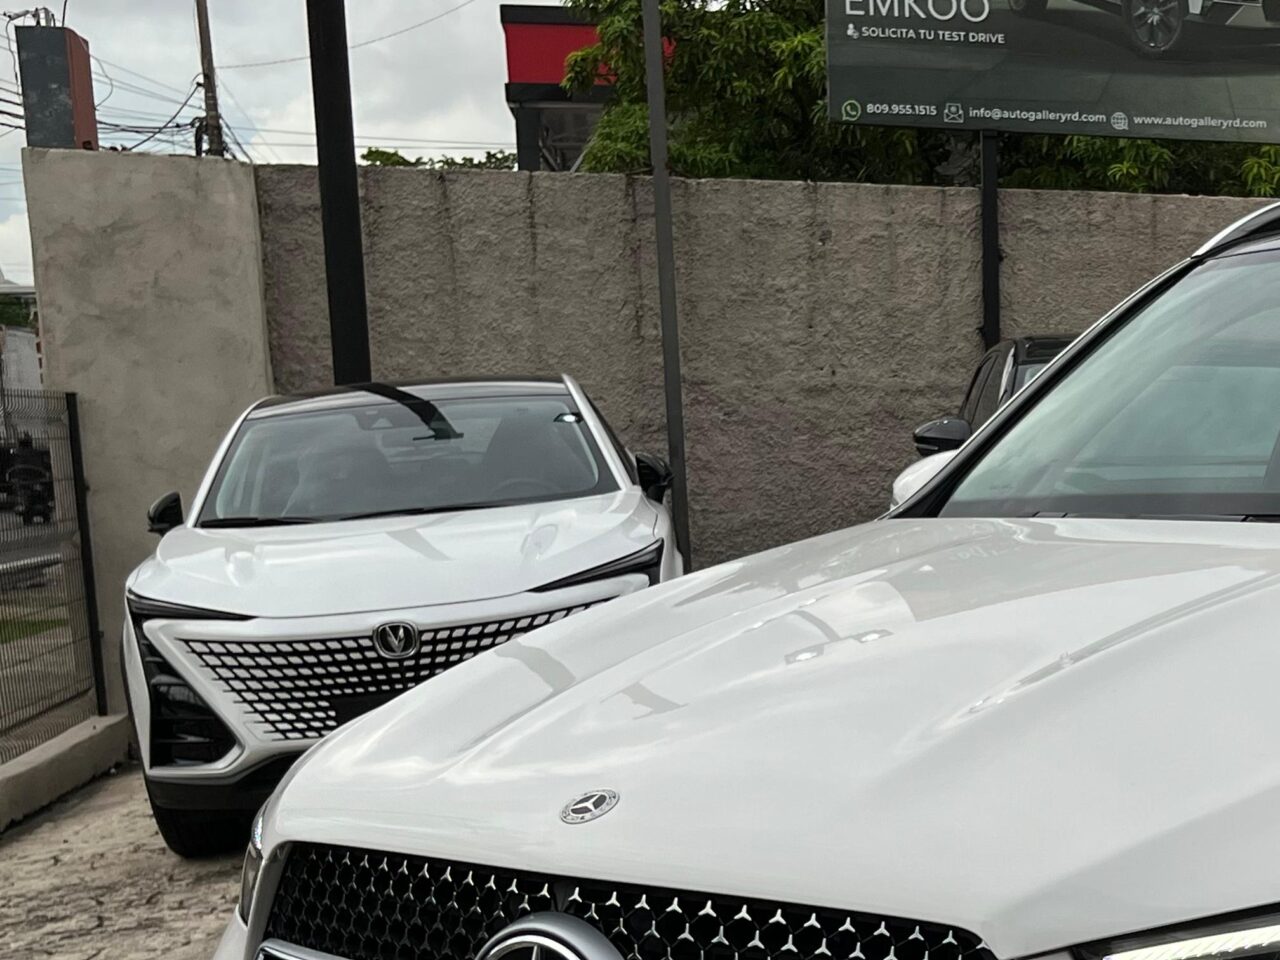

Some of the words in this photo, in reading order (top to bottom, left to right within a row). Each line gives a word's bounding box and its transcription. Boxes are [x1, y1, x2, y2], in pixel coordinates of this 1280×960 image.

[862, 27, 916, 39] SOLICITA
[919, 29, 934, 40] TU
[937, 30, 966, 42] TEST
[969, 32, 1005, 44] DRIVE
[866, 103, 937, 116] 809.955.1515
[969, 106, 1106, 123] info@autogalleryrd.com
[1133, 114, 1267, 129] www.autogalleryrd.com
